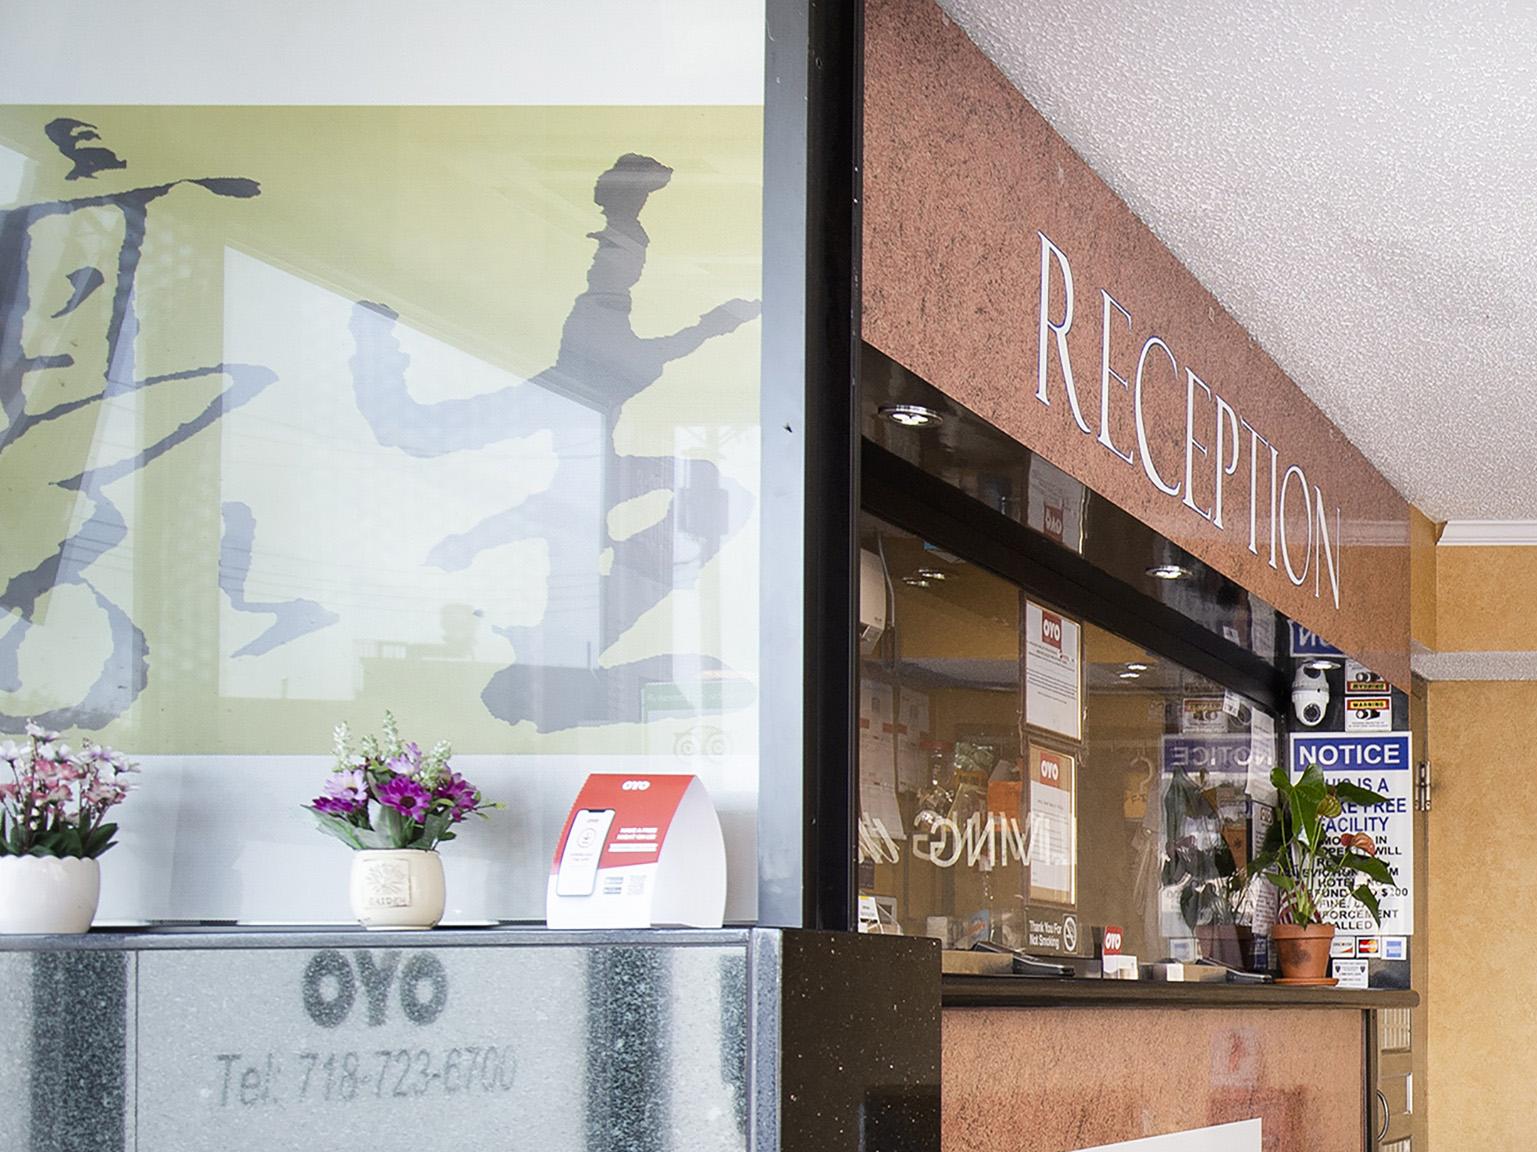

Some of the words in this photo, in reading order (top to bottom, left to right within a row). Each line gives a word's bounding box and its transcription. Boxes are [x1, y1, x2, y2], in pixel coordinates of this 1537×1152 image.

[1036, 230, 1341, 610] RECEPTION
[1043, 618, 1061, 641] OYO
[1299, 743, 1401, 766] NOTICE
[1041, 760, 1059, 781] OYO
[622, 780, 651, 791] OYO
[1377, 778, 1389, 792] A
[1375, 836, 1387, 844] IN
[1374, 847, 1402, 855] WILL
[1029, 919, 1044, 932] Thank
[1039, 934, 1060, 950] Smoking
[1105, 931, 1121, 950] OYO
[302, 948, 449, 1028] OYO
[301, 1044, 519, 1100] 718-723-6700
